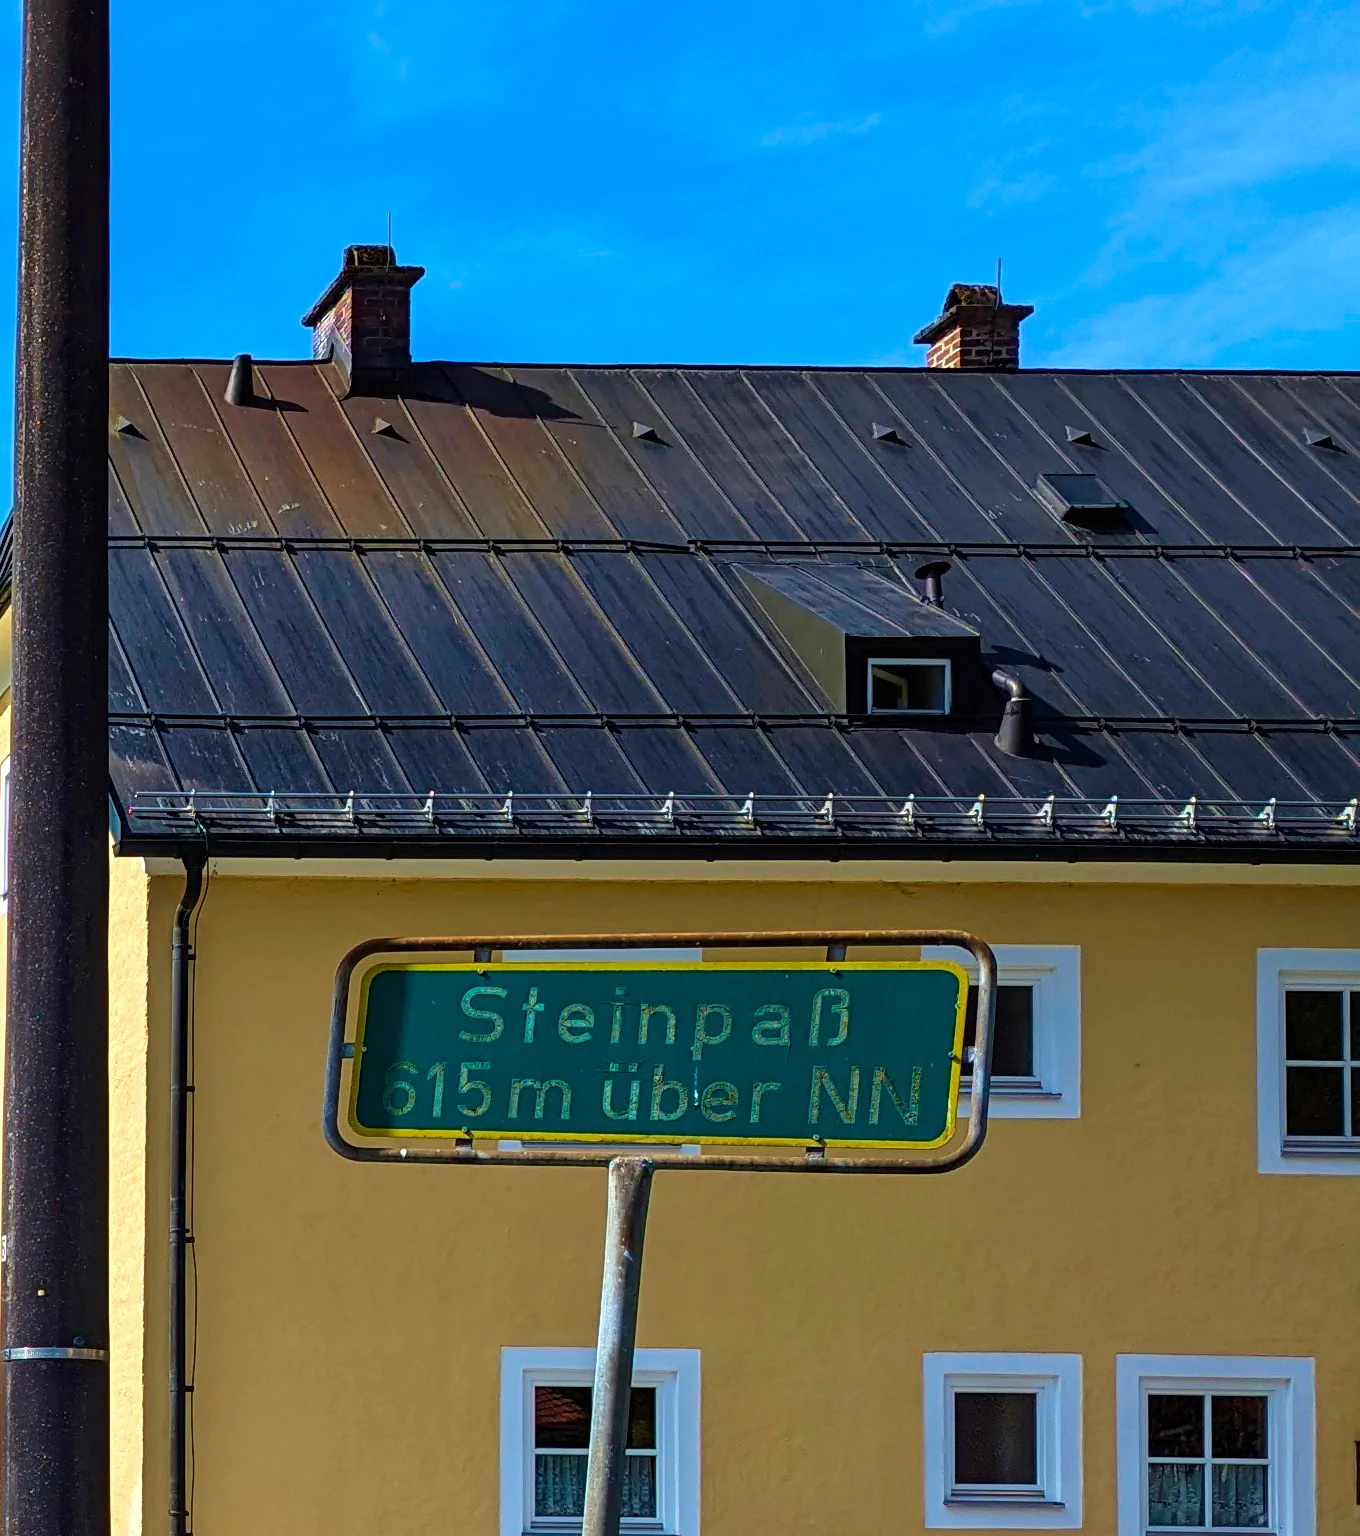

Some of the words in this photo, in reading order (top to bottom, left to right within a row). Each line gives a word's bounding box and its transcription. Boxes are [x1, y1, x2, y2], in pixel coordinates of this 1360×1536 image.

[459, 985, 849, 1061] Steinpaß
[602, 1061, 782, 1123] über
[808, 1064, 924, 1127] NN
